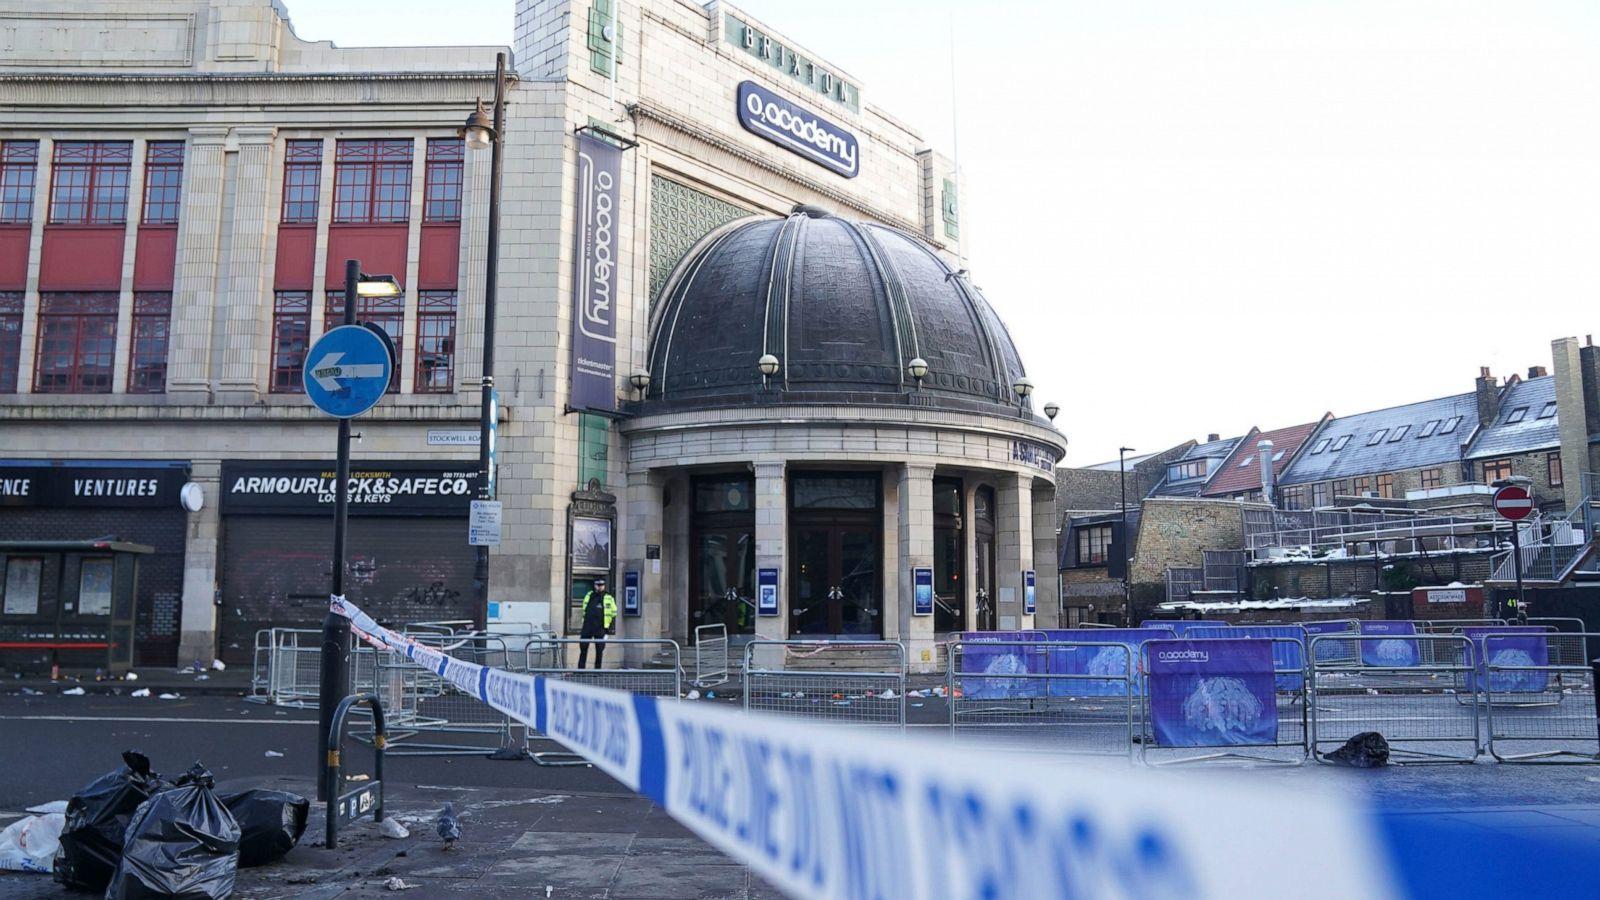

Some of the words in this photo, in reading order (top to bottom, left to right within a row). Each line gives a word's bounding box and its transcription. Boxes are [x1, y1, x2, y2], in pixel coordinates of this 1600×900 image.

[744, 26, 848, 102] BRIXTON
[350, 471, 392, 479] LOCKSMITH
[74, 479, 158, 496] VENTURES
[318, 493, 353, 503] LOS
[354, 494, 362, 503] &
[364, 494, 392, 503] KEYS
